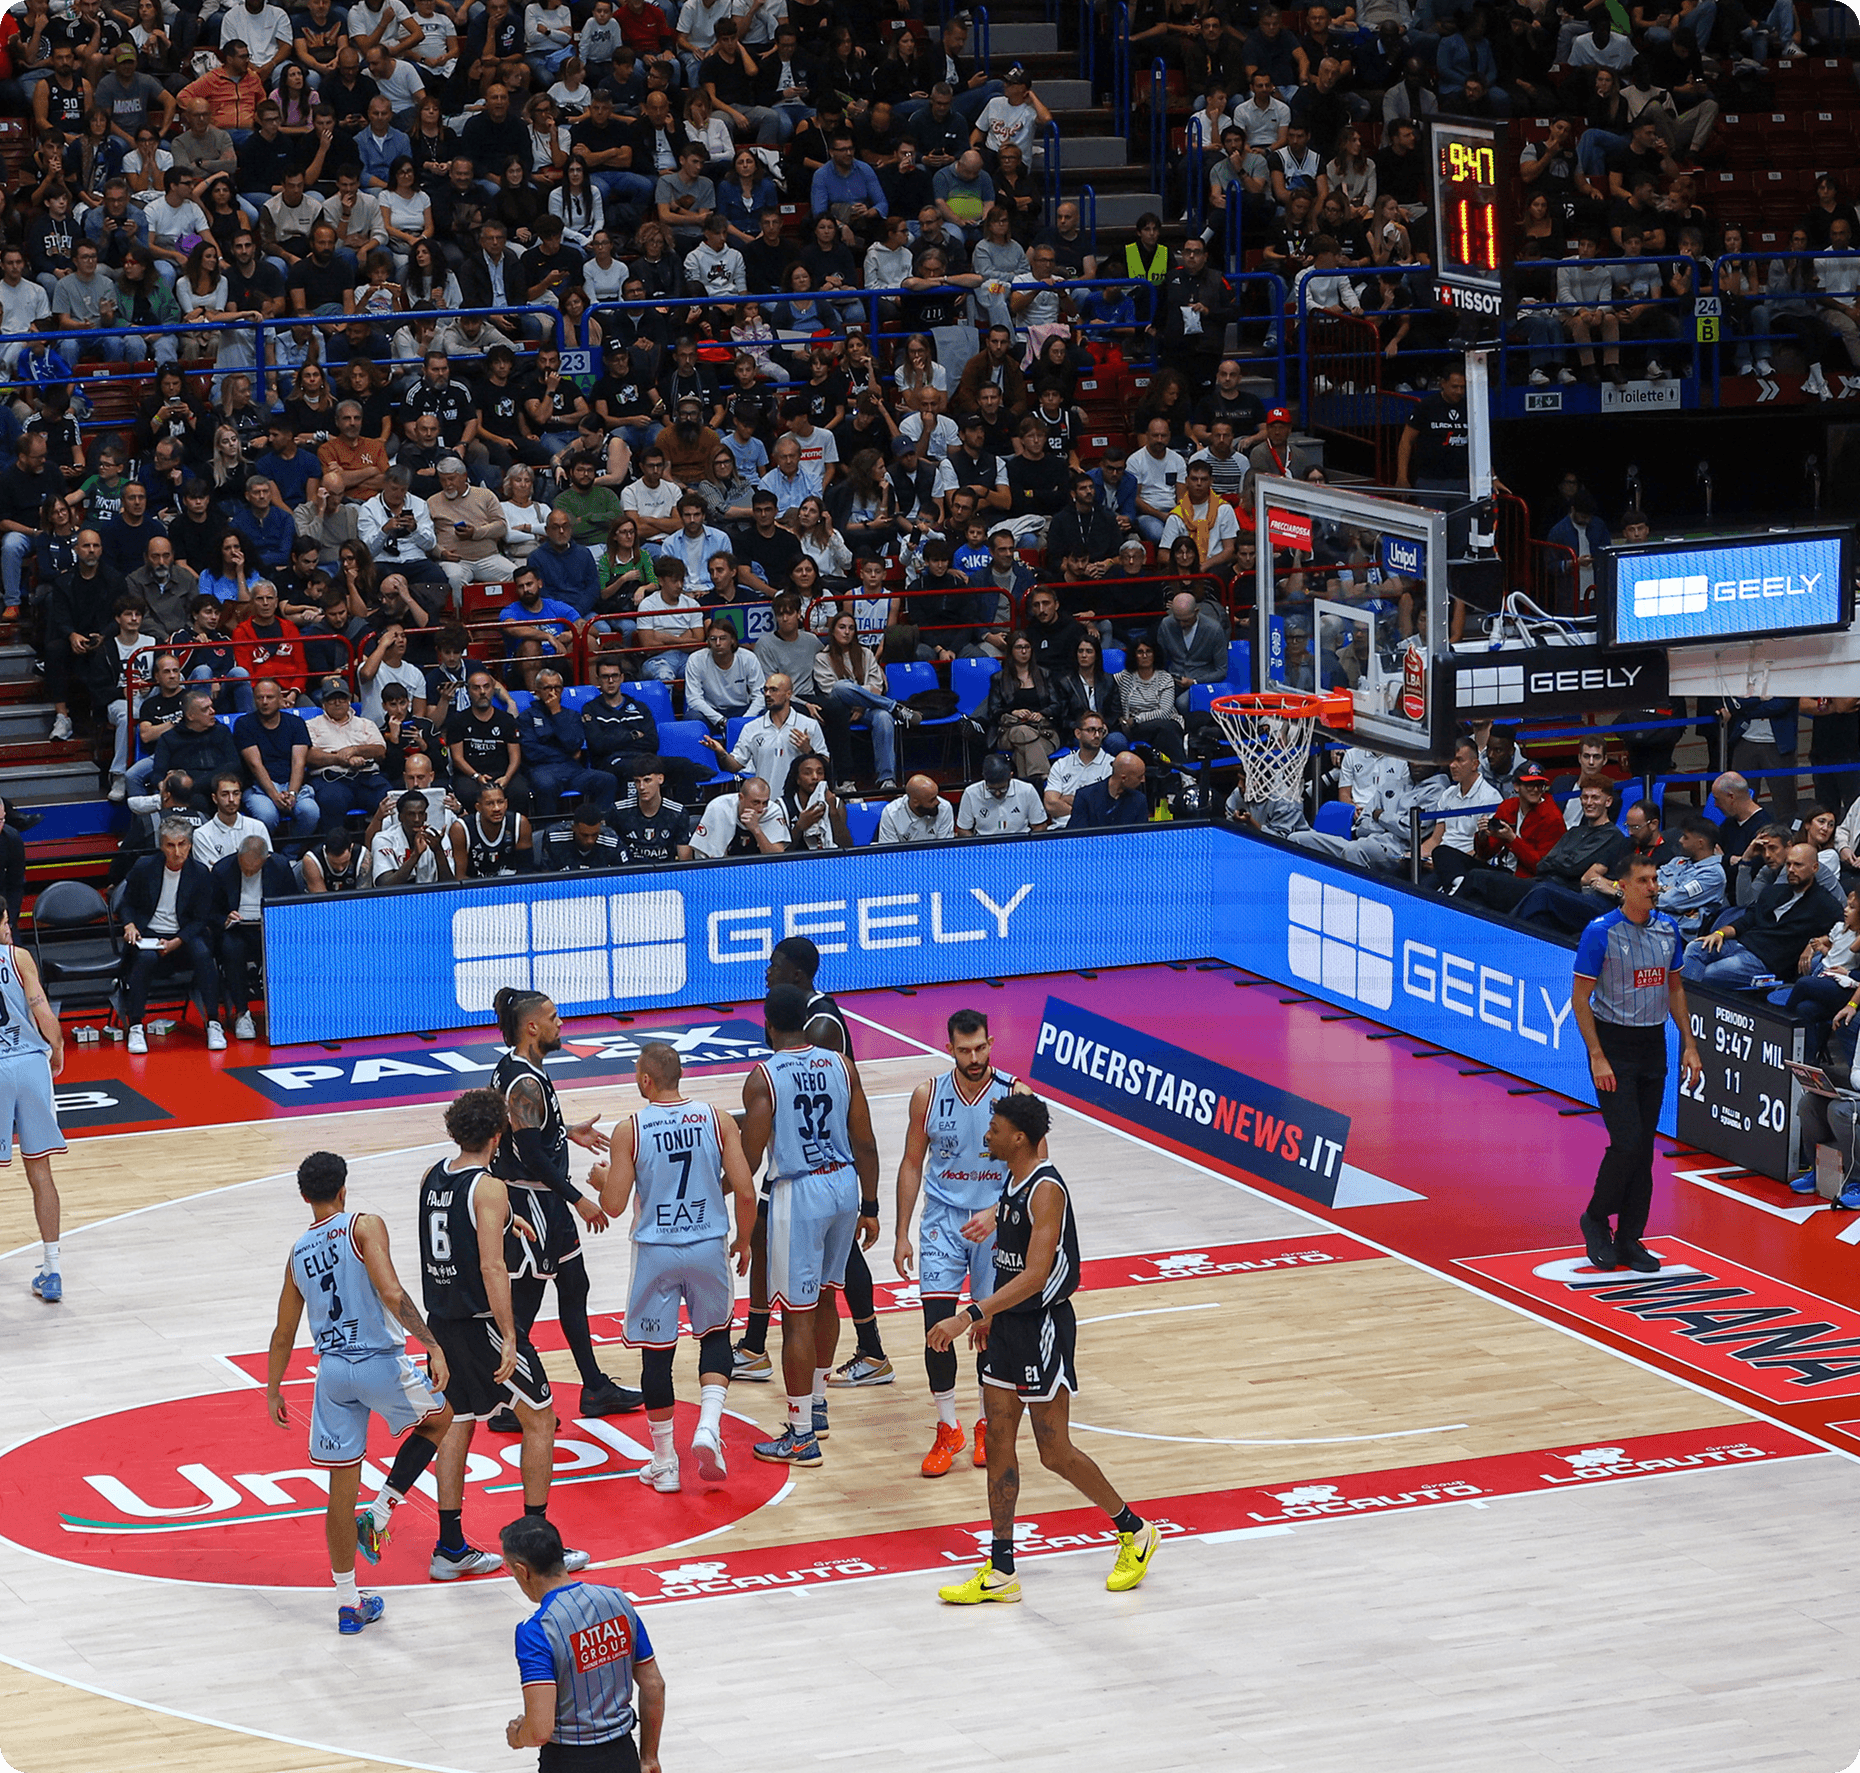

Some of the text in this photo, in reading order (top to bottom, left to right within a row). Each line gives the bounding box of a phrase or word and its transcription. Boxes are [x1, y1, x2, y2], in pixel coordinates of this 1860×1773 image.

[63, 98, 78, 109] 30
[113, 99, 142, 113] MARVEL
[1449, 142, 1496, 186] 9:47
[1459, 199, 1497, 271] 11
[1452, 288, 1502, 316] TISSOT
[1698, 299, 1718, 315] 24
[1702, 325, 1714, 341] B
[560, 353, 585, 371] 23
[1619, 389, 1664, 403] Toilette
[1270, 520, 1311, 538] FRECCIAROSSA
[1388, 542, 1417, 571] Unipol
[1714, 572, 1822, 602] GEELY
[748, 612, 774, 632] 23
[1270, 657, 1283, 668] FIP
[1406, 672, 1421, 687] LBA
[1529, 666, 1642, 694] GEELY
[470, 741, 496, 751] VIRTUS
[708, 884, 1035, 964] GEELY
[1637, 968, 1662, 979] ATTAL
[1403, 938, 1572, 1050] GEELY
[1690, 1013, 1707, 1040] OL
[1715, 1006, 1755, 1031] PERIODO 2
[1715, 1026, 1753, 1062] 9:47
[1762, 1041, 1785, 1070] MIL
[810, 1058, 833, 1070] AON
[792, 1071, 827, 1092] NEBO
[1724, 1067, 1742, 1094] 11
[939, 1098, 955, 1117] 17
[1036, 1021, 1343, 1178] POKERSTARSNEWS.IT
[1711, 1103, 1719, 1119] 0
[681, 1113, 707, 1125] AON
[793, 1093, 833, 1140] 32
[939, 1121, 956, 1129] EA7
[1743, 1116, 1751, 1132] 0
[1757, 1093, 1786, 1133] 20
[653, 1127, 702, 1153] TONUT
[668, 1150, 693, 1200] 7
[938, 1169, 1002, 1182] Media World
[656, 1198, 707, 1227] EA7
[428, 1210, 453, 1261] 6
[1281, 1249, 1320, 1258] Group
[923, 1272, 940, 1280] EA7
[1129, 1252, 1336, 1283] LOCAUTO
[320, 1271, 343, 1322] 3
[1025, 1365, 1040, 1382] 21
[1706, 1442, 1748, 1453] Group
[1540, 1446, 1767, 1484] LOCAUTO
[1421, 1480, 1466, 1491] Group
[1247, 1483, 1483, 1523] LOCAUTO
[812, 1556, 862, 1569] Group
[626, 1562, 882, 1602] LOCAUTO
[579, 1619, 625, 1651] ATTAL
[580, 1636, 627, 1663] GROUP
